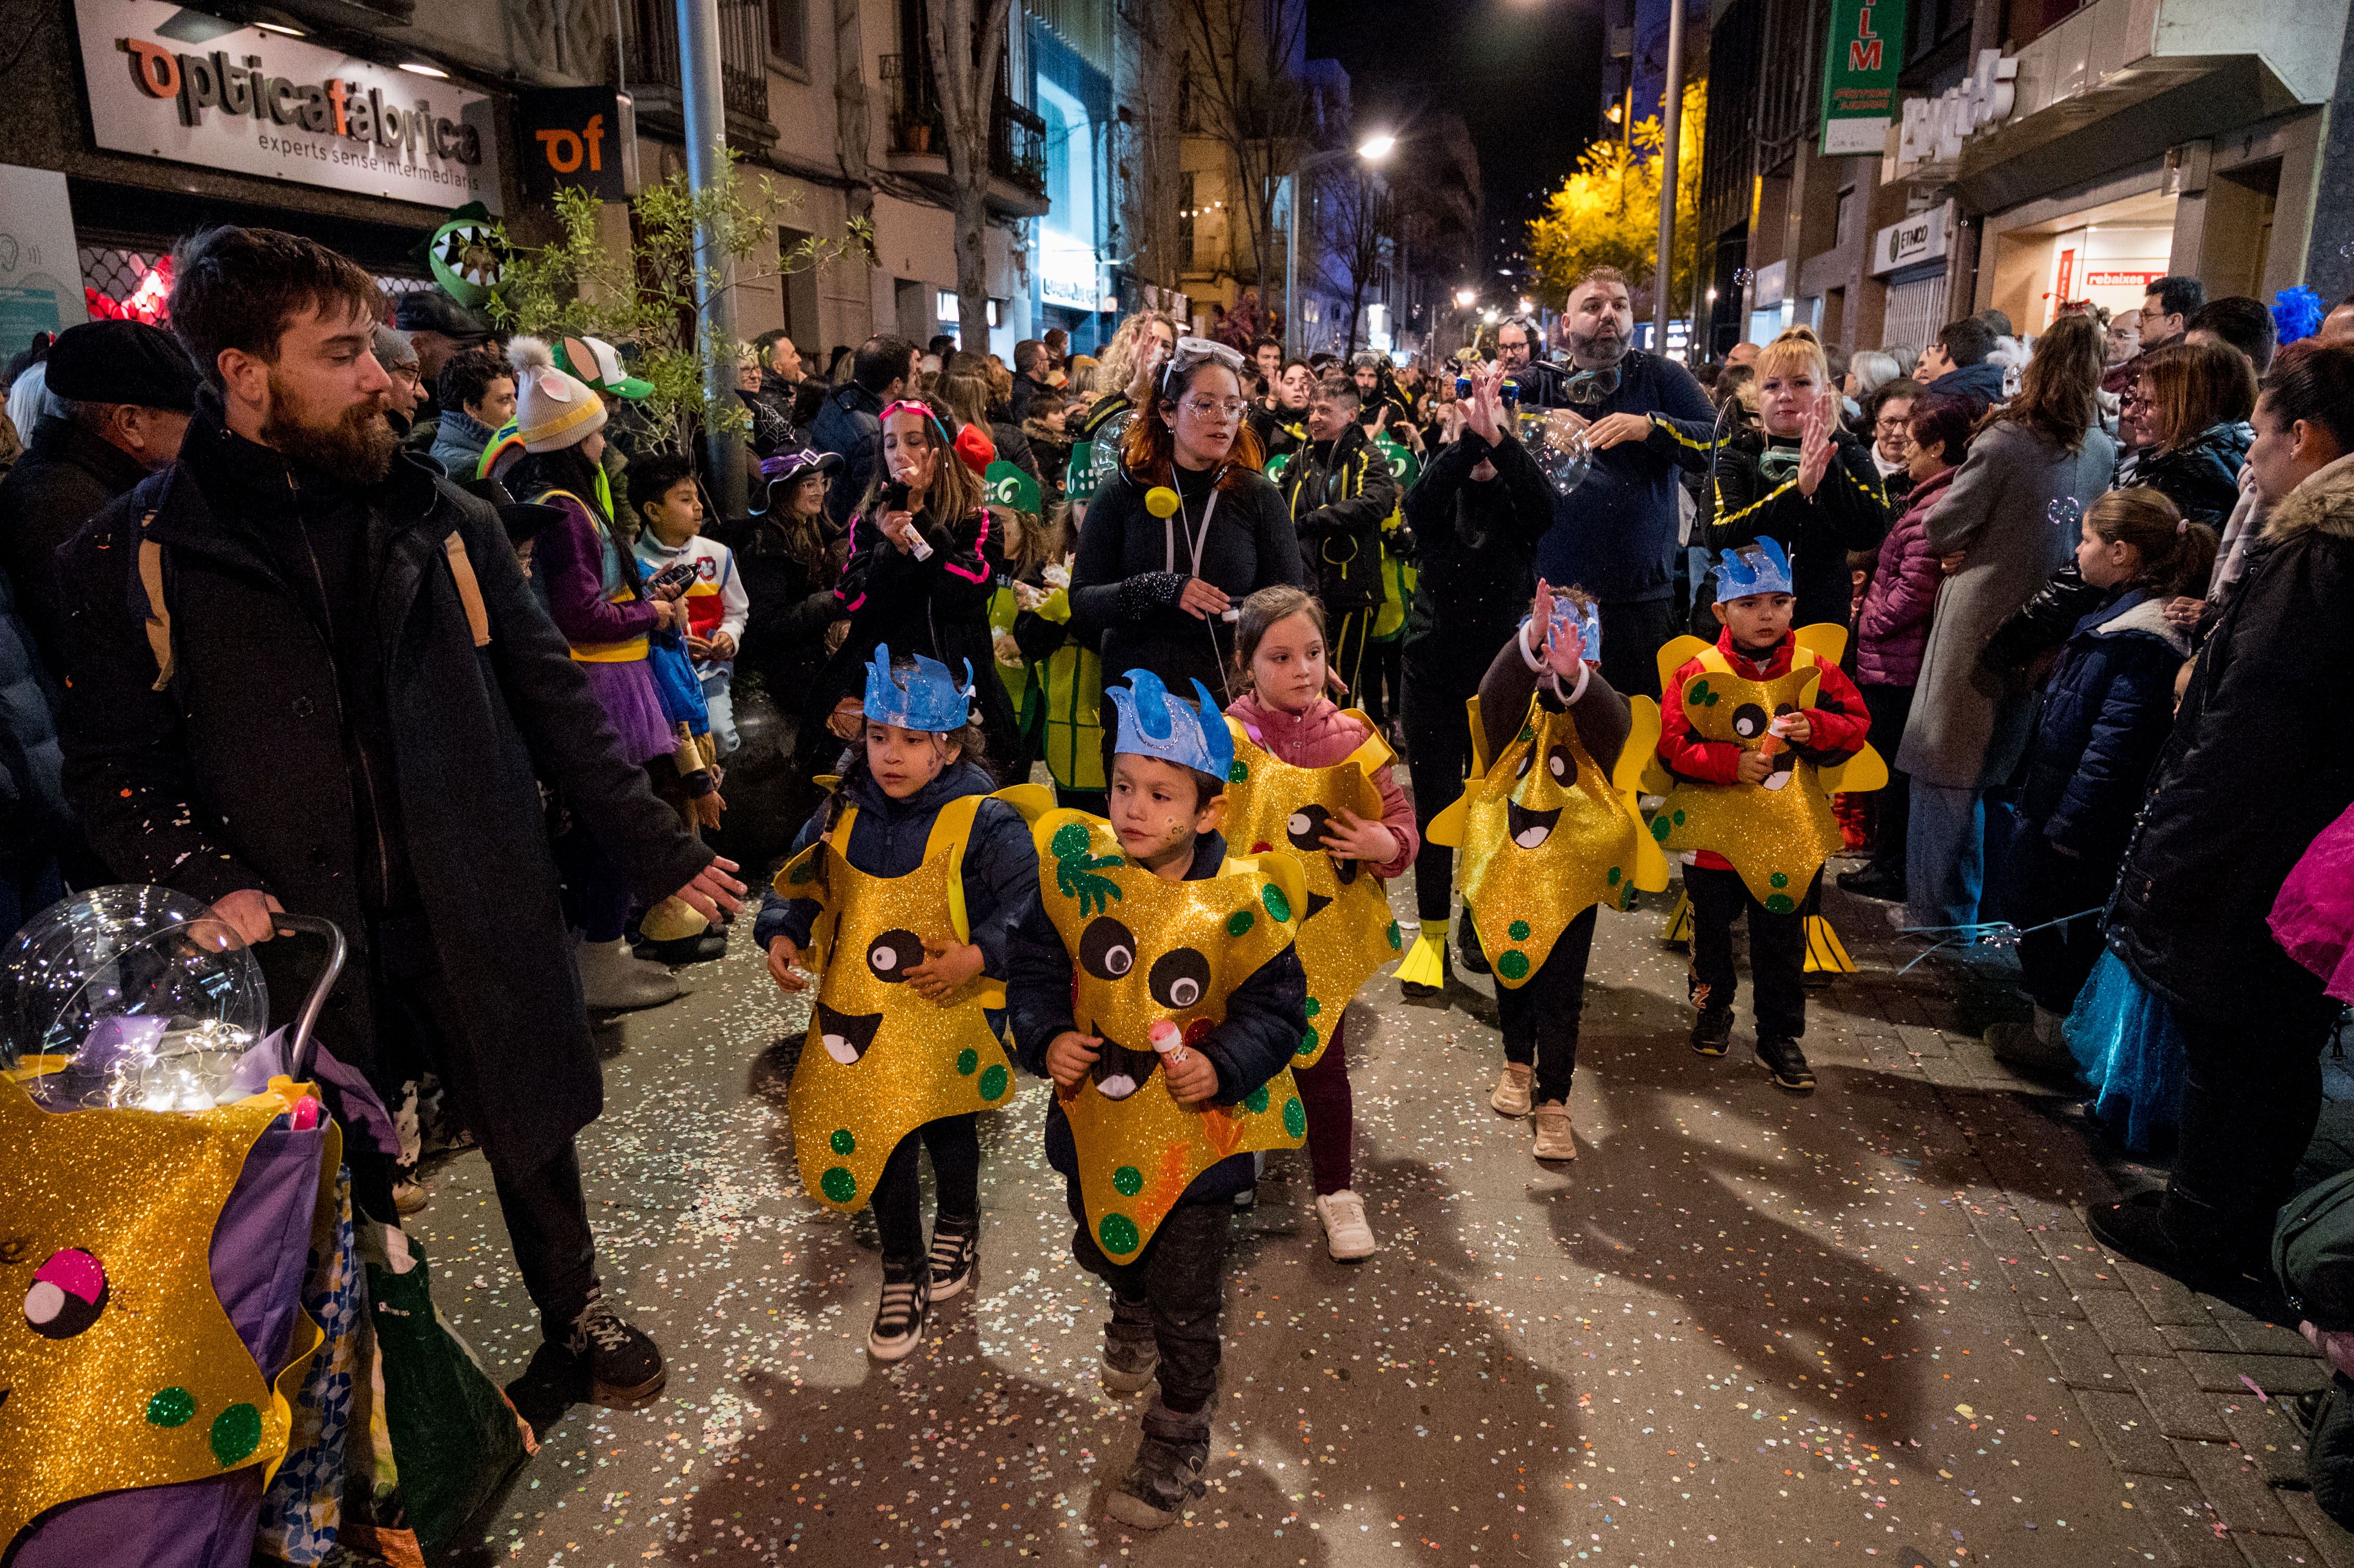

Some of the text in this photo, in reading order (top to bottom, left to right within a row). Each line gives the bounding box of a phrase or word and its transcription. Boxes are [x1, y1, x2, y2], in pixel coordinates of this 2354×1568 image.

[259, 135, 479, 190] experts sense intermediaris
[2089, 273, 2144, 284] rebaixes
